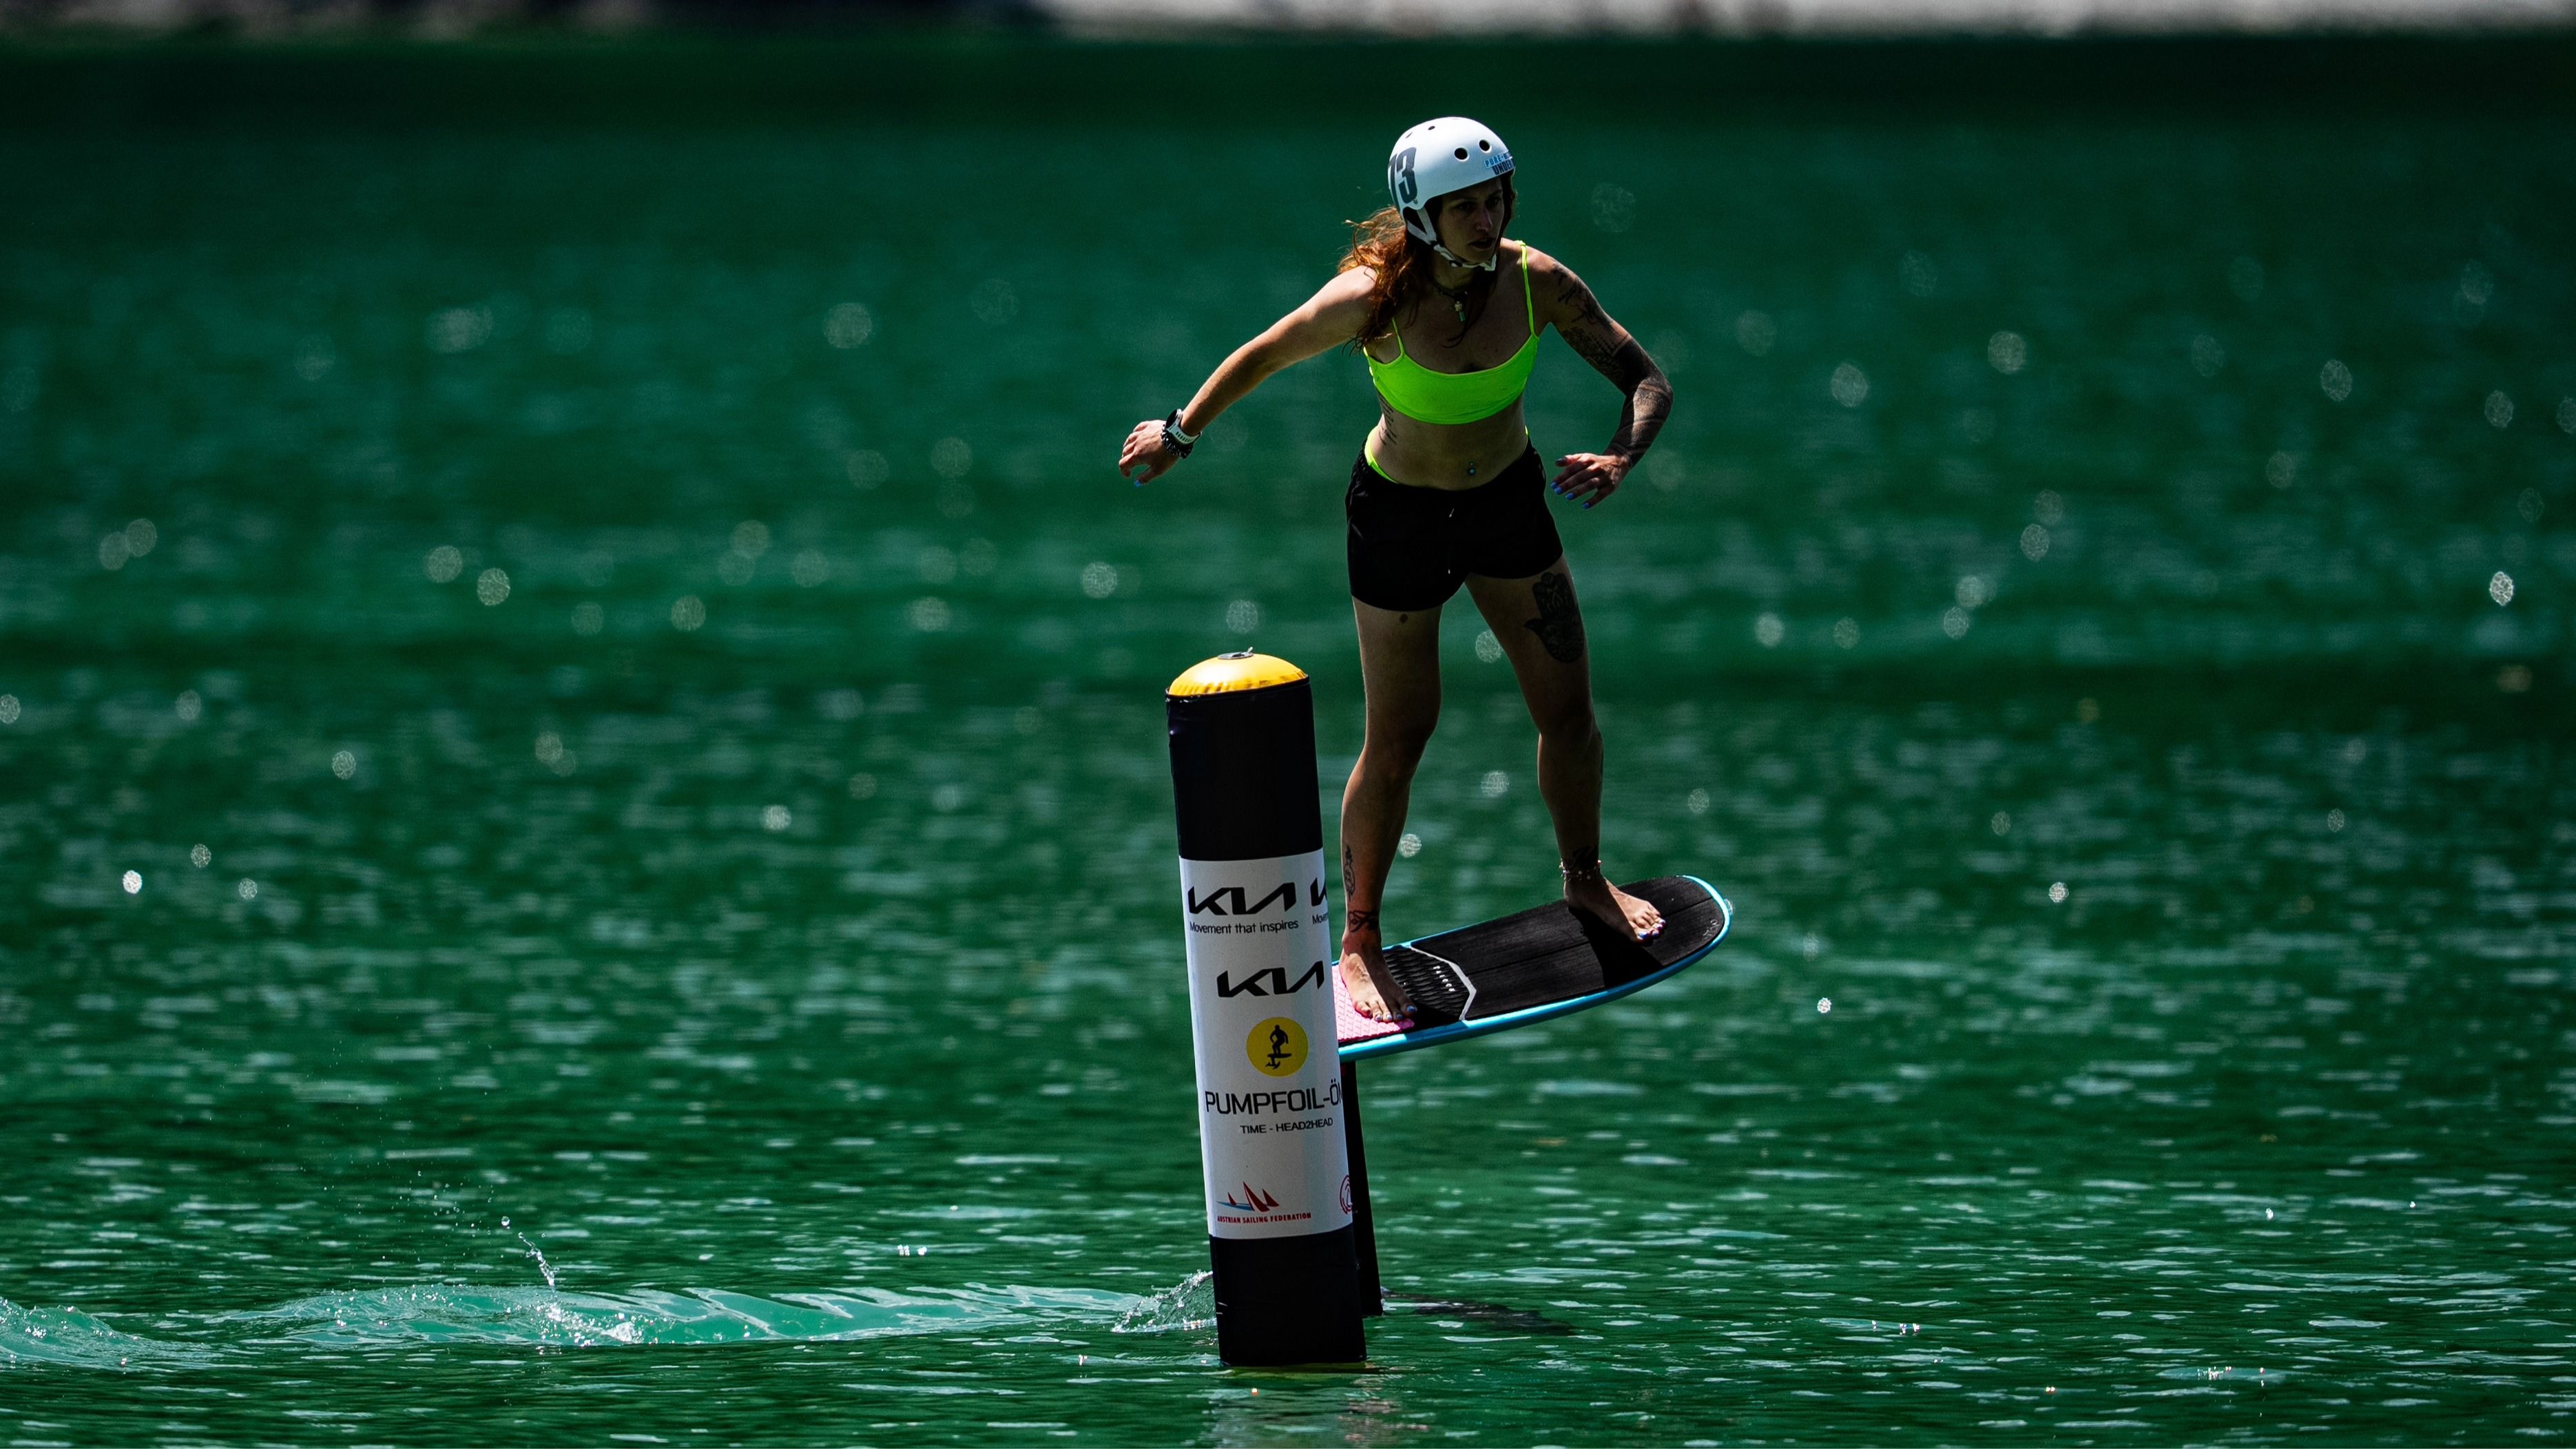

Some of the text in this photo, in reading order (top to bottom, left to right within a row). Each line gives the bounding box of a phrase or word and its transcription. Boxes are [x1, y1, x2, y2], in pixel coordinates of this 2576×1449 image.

[1187, 882, 1297, 916] KIA
[1190, 919, 1299, 935] Movement that inspires
[1216, 960, 1325, 998] KIA
[1240, 1124, 1267, 1134] TIME
[1276, 1117, 1333, 1132] HEAD2HEAD
[1217, 1212, 1311, 1224] AUSTRIAN SAILING FEDERATION
